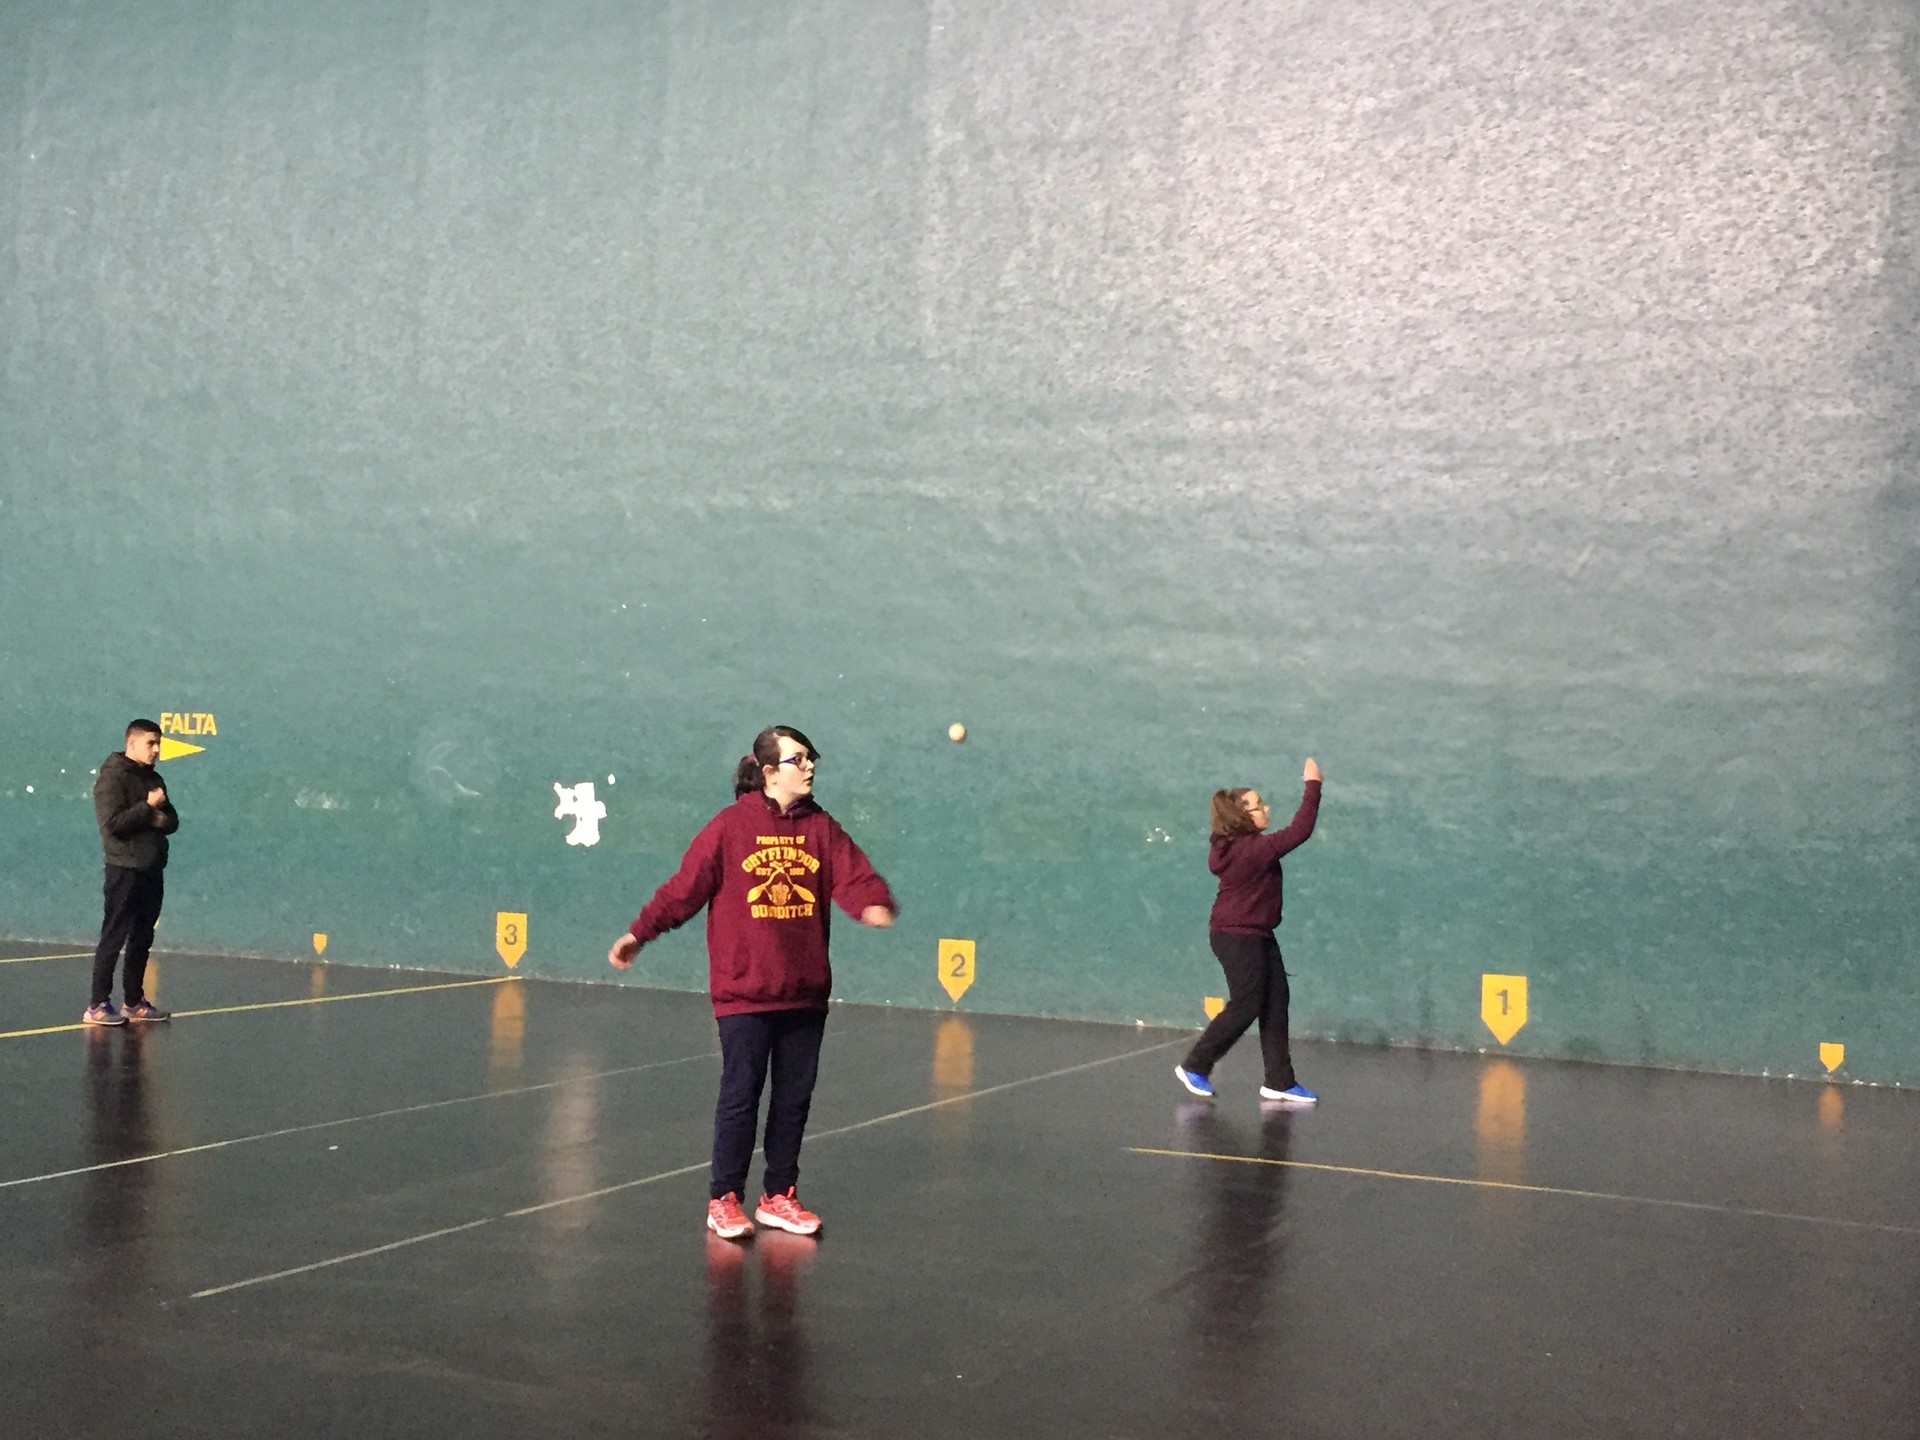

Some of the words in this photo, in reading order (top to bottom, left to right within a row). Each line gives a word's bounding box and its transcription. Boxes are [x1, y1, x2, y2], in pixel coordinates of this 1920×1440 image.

[159, 712, 217, 736] FALTA
[796, 835, 806, 844] OF
[755, 867, 772, 876] EST
[504, 923, 518, 946] 3
[950, 952, 967, 978] 2
[1496, 988, 1511, 1016] 1
